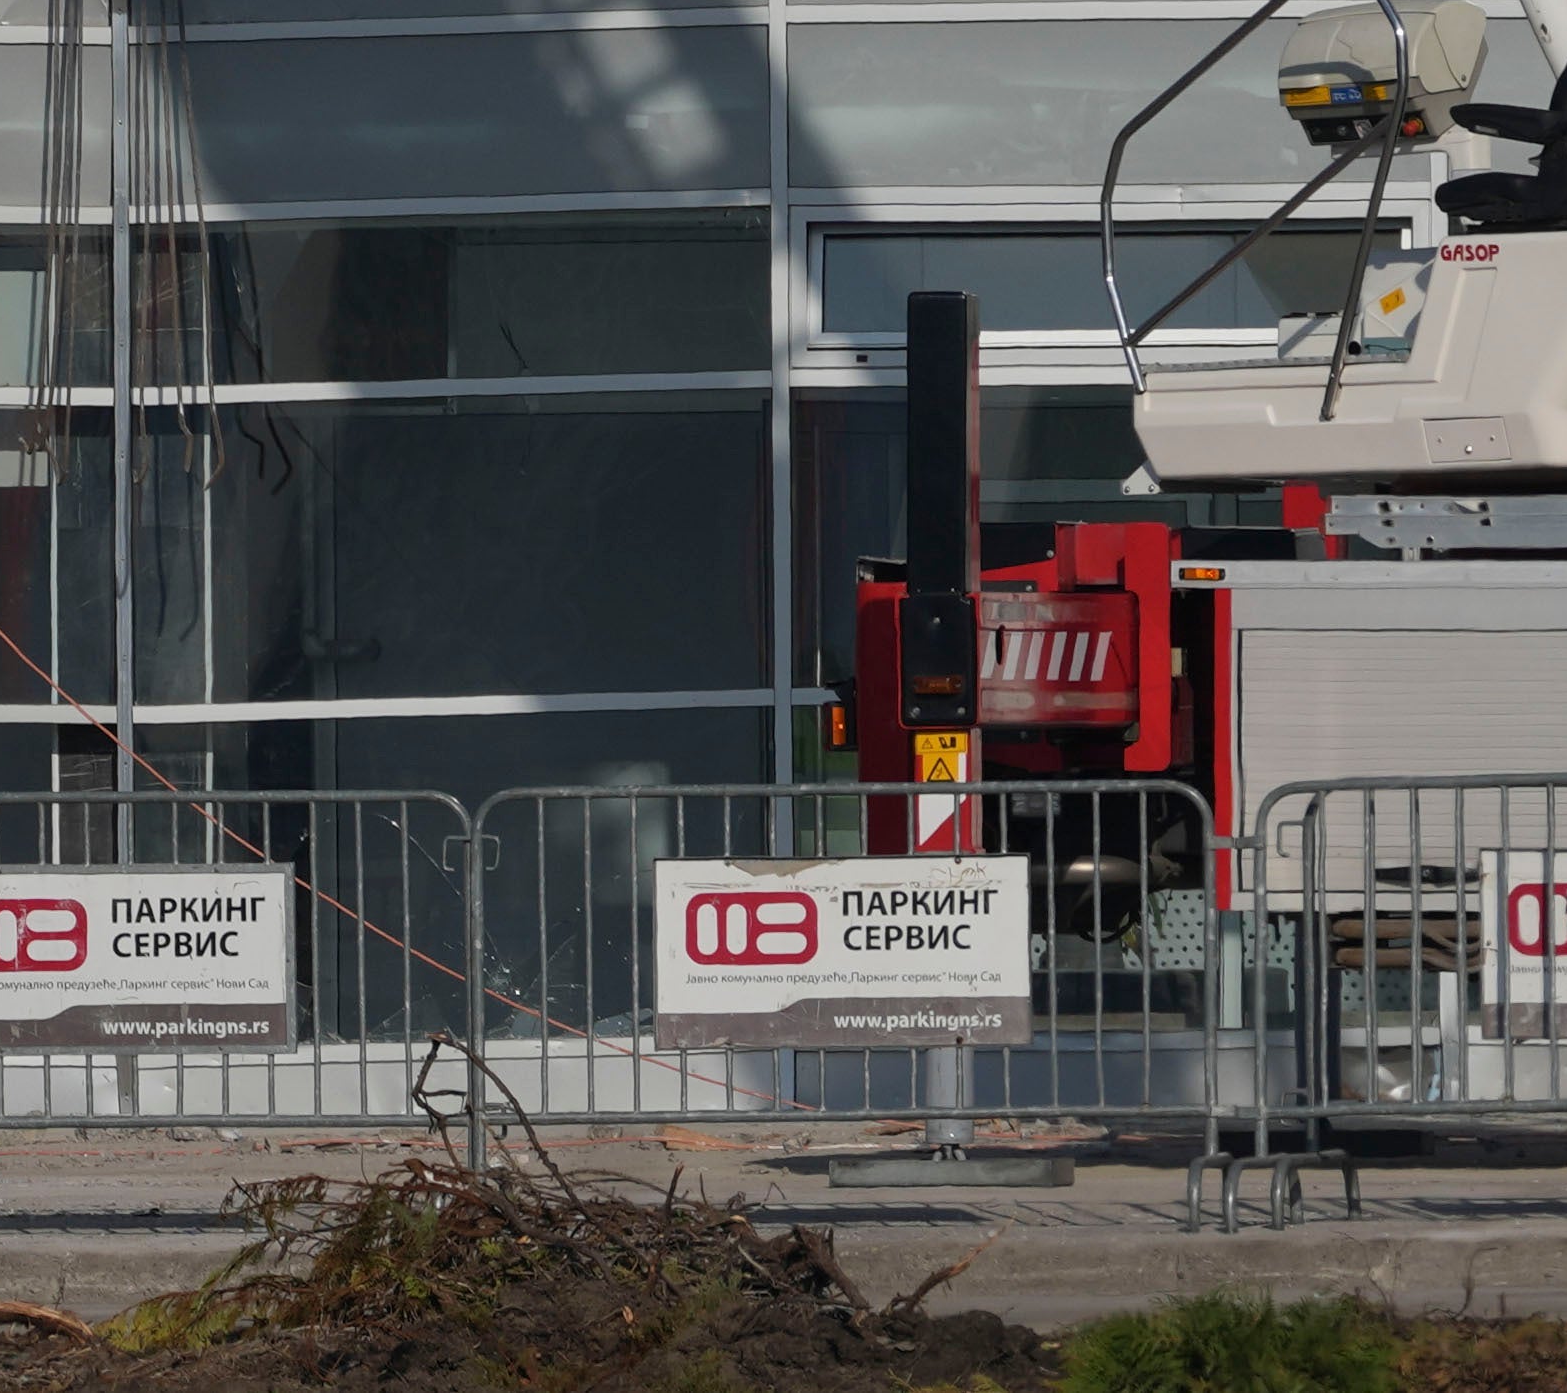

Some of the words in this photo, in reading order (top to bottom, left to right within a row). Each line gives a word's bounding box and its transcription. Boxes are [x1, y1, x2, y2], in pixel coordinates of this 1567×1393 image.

[1440, 244, 1500, 262] GASOP
[111, 897, 266, 923] ПАРКИНГ
[842, 889, 998, 916] ПАРКИНГ
[112, 931, 240, 958] СЕРВИС
[843, 925, 972, 951] СЕРВИС
[56, 978, 116, 993] предузеће
[216, 979, 246, 989] Нови
[248, 978, 270, 990] Сад
[686, 973, 718, 985] Јавно
[722, 974, 784, 986] комунално
[786, 973, 847, 986] предузеће
[948, 971, 978, 983] Нови
[980, 971, 1002, 984] Сад
[102, 1017, 270, 1039] www.parkingns.rs
[834, 1009, 1002, 1032] www.parkingns.rs
